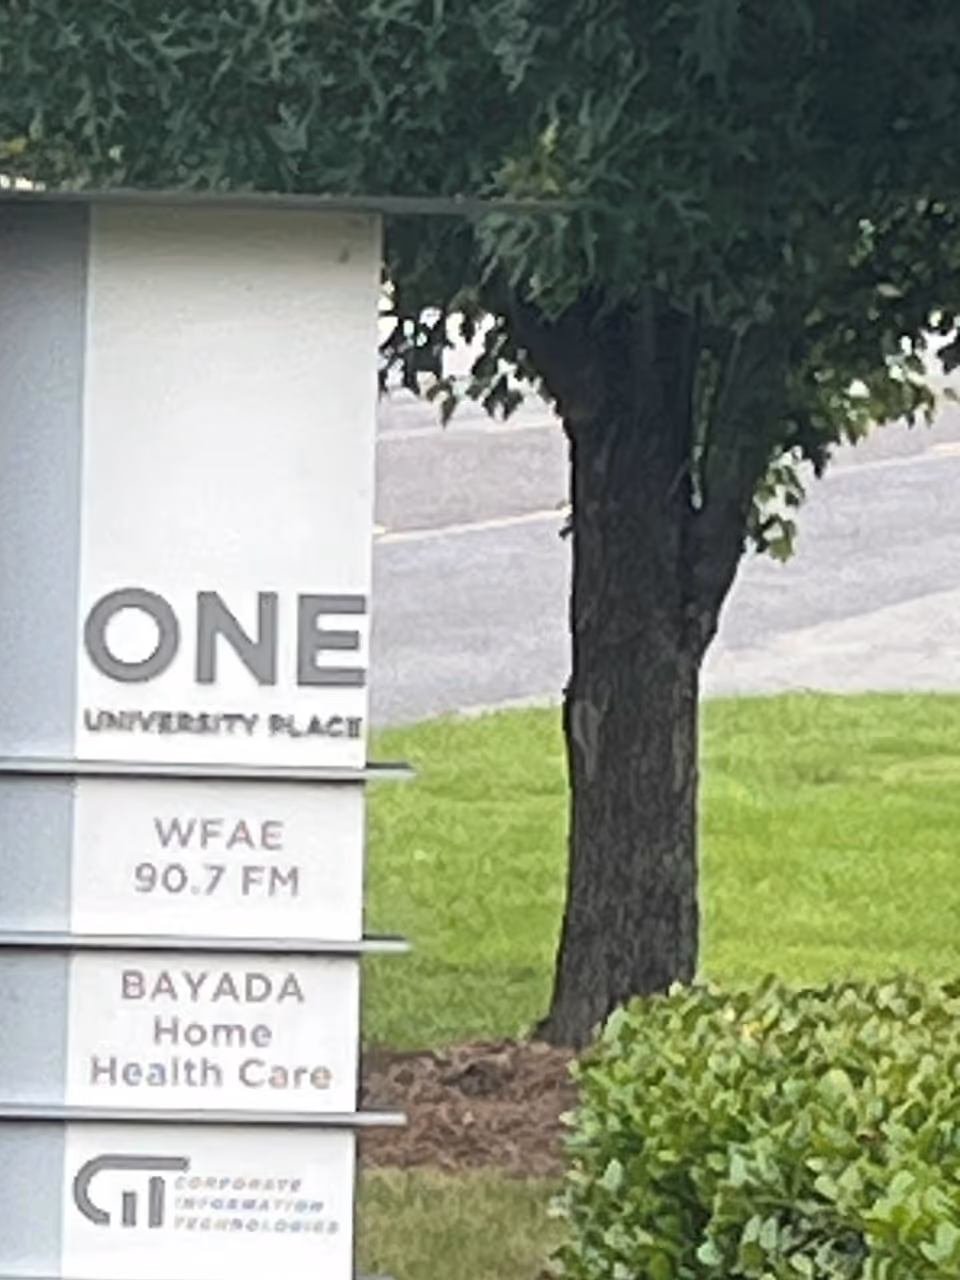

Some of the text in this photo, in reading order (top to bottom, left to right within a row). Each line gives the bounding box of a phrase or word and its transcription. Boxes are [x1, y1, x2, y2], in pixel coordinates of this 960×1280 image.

[84, 587, 367, 688] ONE
[84, 710, 364, 740] UNIVERSITY PLACE
[153, 817, 285, 850] WFAE
[135, 862, 299, 896] 90.7 FM
[121, 970, 305, 1003] BAYADA
[153, 1015, 272, 1047] Home
[90, 1056, 332, 1090] Health Care
